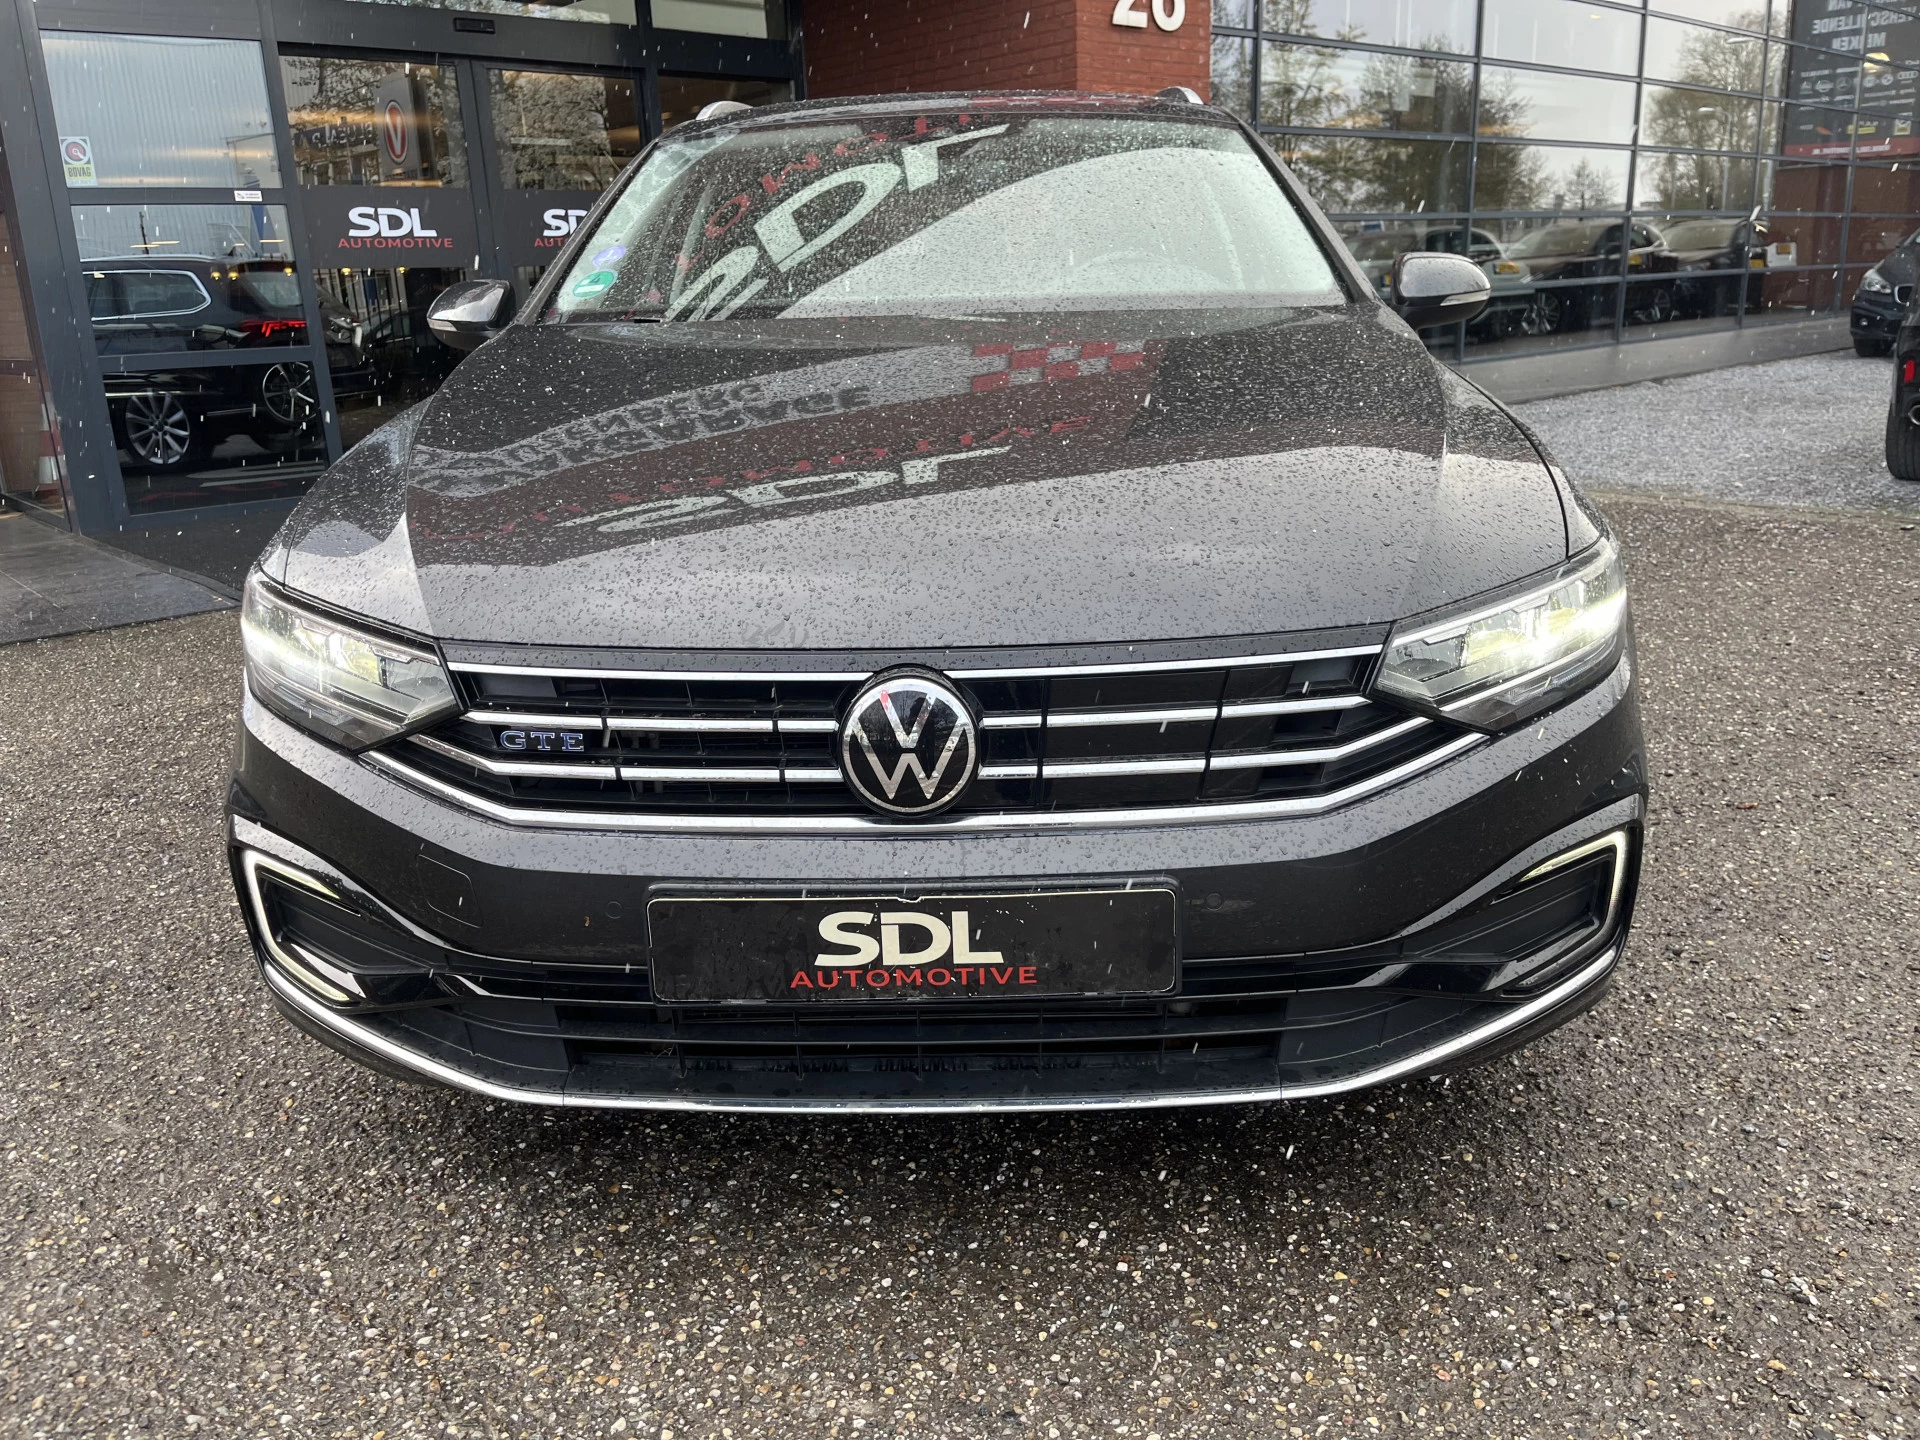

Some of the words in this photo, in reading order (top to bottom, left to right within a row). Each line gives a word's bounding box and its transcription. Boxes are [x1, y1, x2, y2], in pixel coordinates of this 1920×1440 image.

[67, 166, 92, 178] BOVAG
[348, 206, 438, 237] SDL
[338, 238, 454, 248] AUTOMOTIVE
[500, 730, 584, 751] GTE
[814, 911, 1004, 967] SDL
[790, 966, 1037, 988] AUTOMOTIVE
